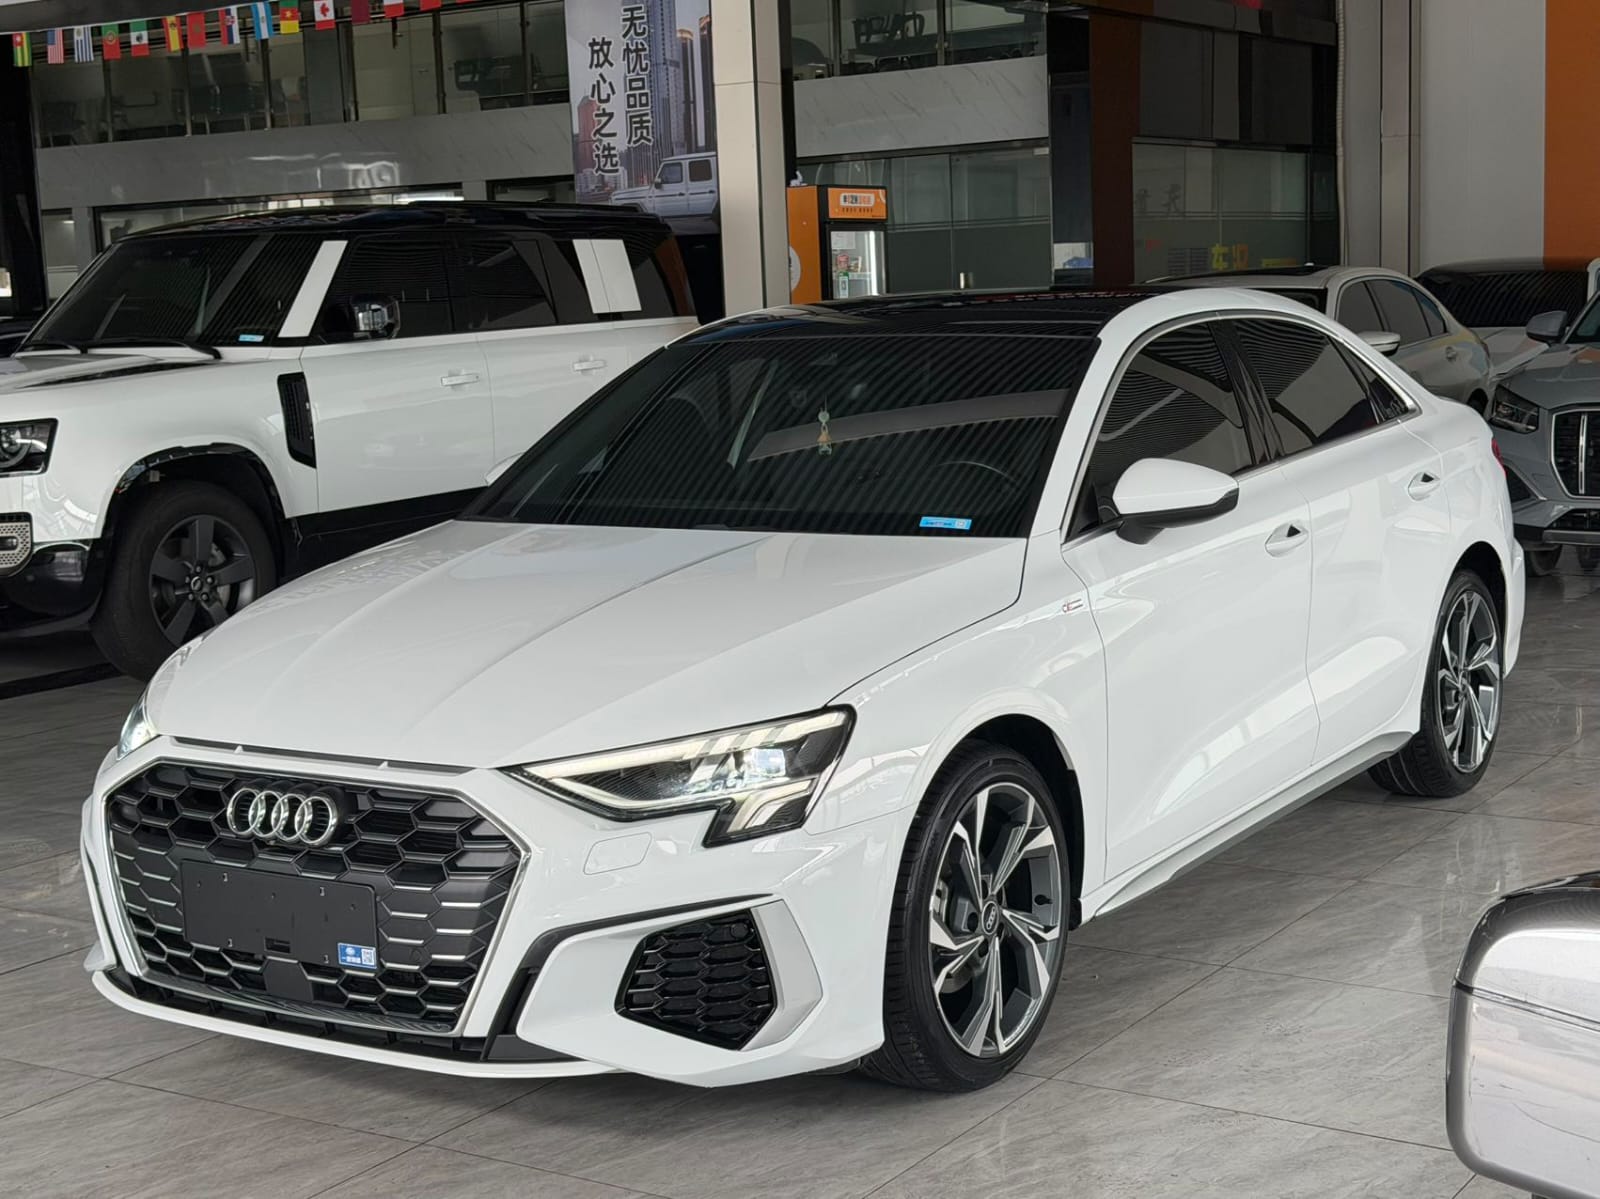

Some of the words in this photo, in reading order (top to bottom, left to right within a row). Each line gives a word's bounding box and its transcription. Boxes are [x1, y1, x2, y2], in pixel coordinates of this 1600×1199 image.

[588, 37, 619, 174] 放心之选
[622, 6, 652, 145] 无忧品质
